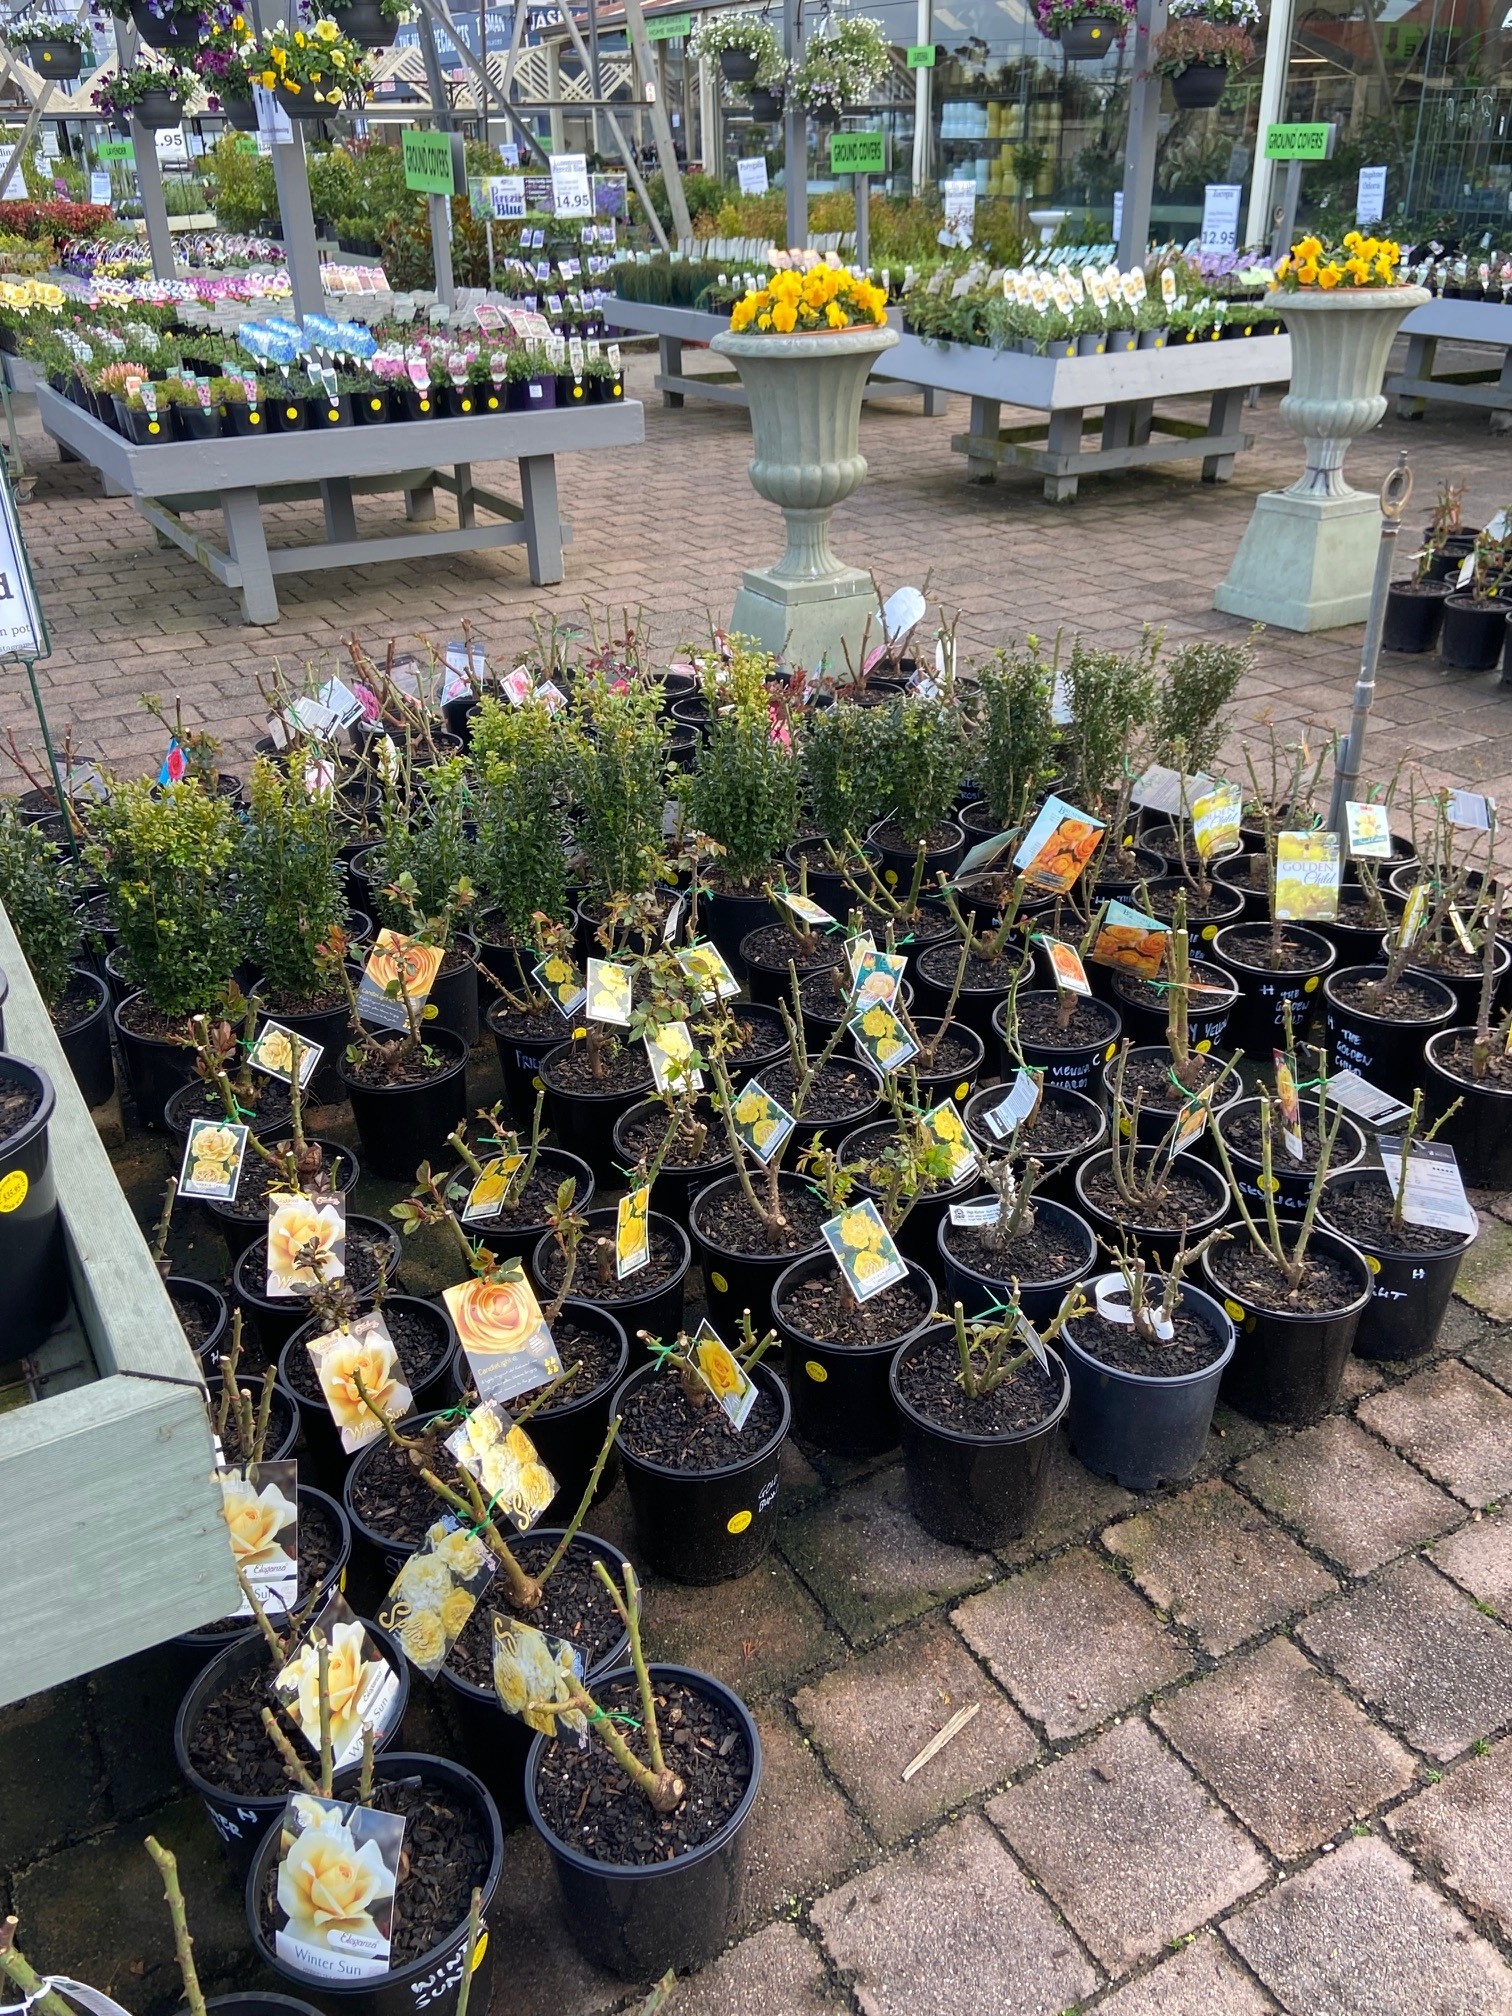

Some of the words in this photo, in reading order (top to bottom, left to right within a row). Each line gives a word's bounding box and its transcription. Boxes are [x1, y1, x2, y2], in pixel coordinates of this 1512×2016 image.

[1269, 133, 1296, 150] GROUND
[1299, 132, 1324, 149] COVERS
[834, 144, 859, 163] GROUND
[860, 142, 882, 160] COVERS
[406, 145, 428, 175] GROUND
[428, 147, 450, 178] COVERS
[556, 194, 590, 208] 14.95
[496, 202, 524, 216] Blue
[1202, 231, 1236, 245] 12.95
[12, 623, 32, 638] pot
[1282, 861, 1334, 873] GOLDEN
[1303, 871, 1337, 885] Child
[1275, 1001, 1310, 1012] GDEN
[1274, 1015, 1304, 1025] CLD
[1336, 1041, 1373, 1067] GOLDEN
[345, 1420, 385, 1441] Winte
[385, 1406, 407, 1421] Sun
[373, 1697, 388, 1719] Sun
[295, 1945, 335, 1970] Winter
[338, 1960, 361, 1976] Sun
